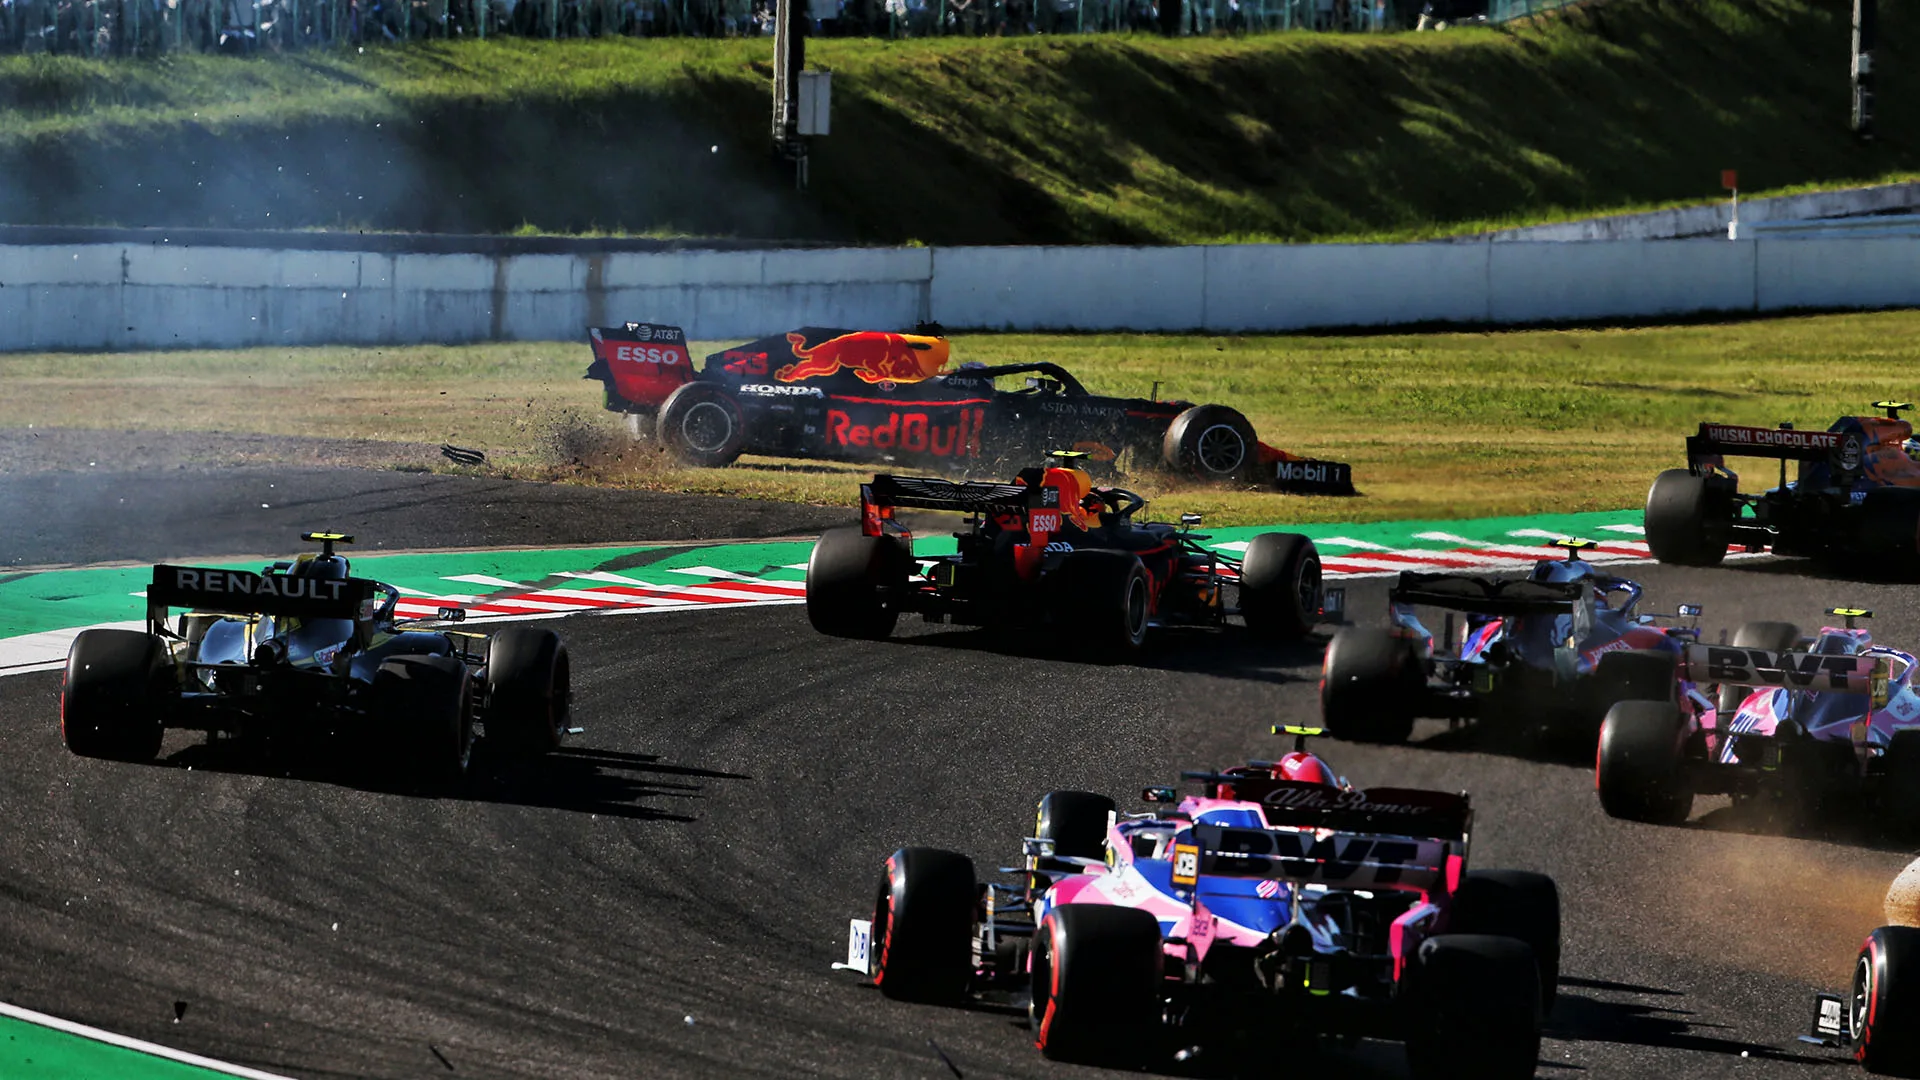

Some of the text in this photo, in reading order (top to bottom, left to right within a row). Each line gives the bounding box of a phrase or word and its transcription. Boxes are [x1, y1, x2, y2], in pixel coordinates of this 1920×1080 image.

[654, 329, 680, 340] AT&T
[617, 346, 679, 365] ESSO
[740, 384, 825, 399] HONDA
[1041, 402, 1077, 415] ASTON
[1709, 427, 1837, 447] HUSKI CHOCOLATE
[1277, 461, 1340, 482] Mobil 1
[1033, 514, 1057, 532] ESSO
[176, 569, 348, 600] RENAULT
[1708, 647, 1857, 688] BWT
[1263, 787, 1432, 816] Alfa Romeo
[1213, 829, 1418, 883] BWT
